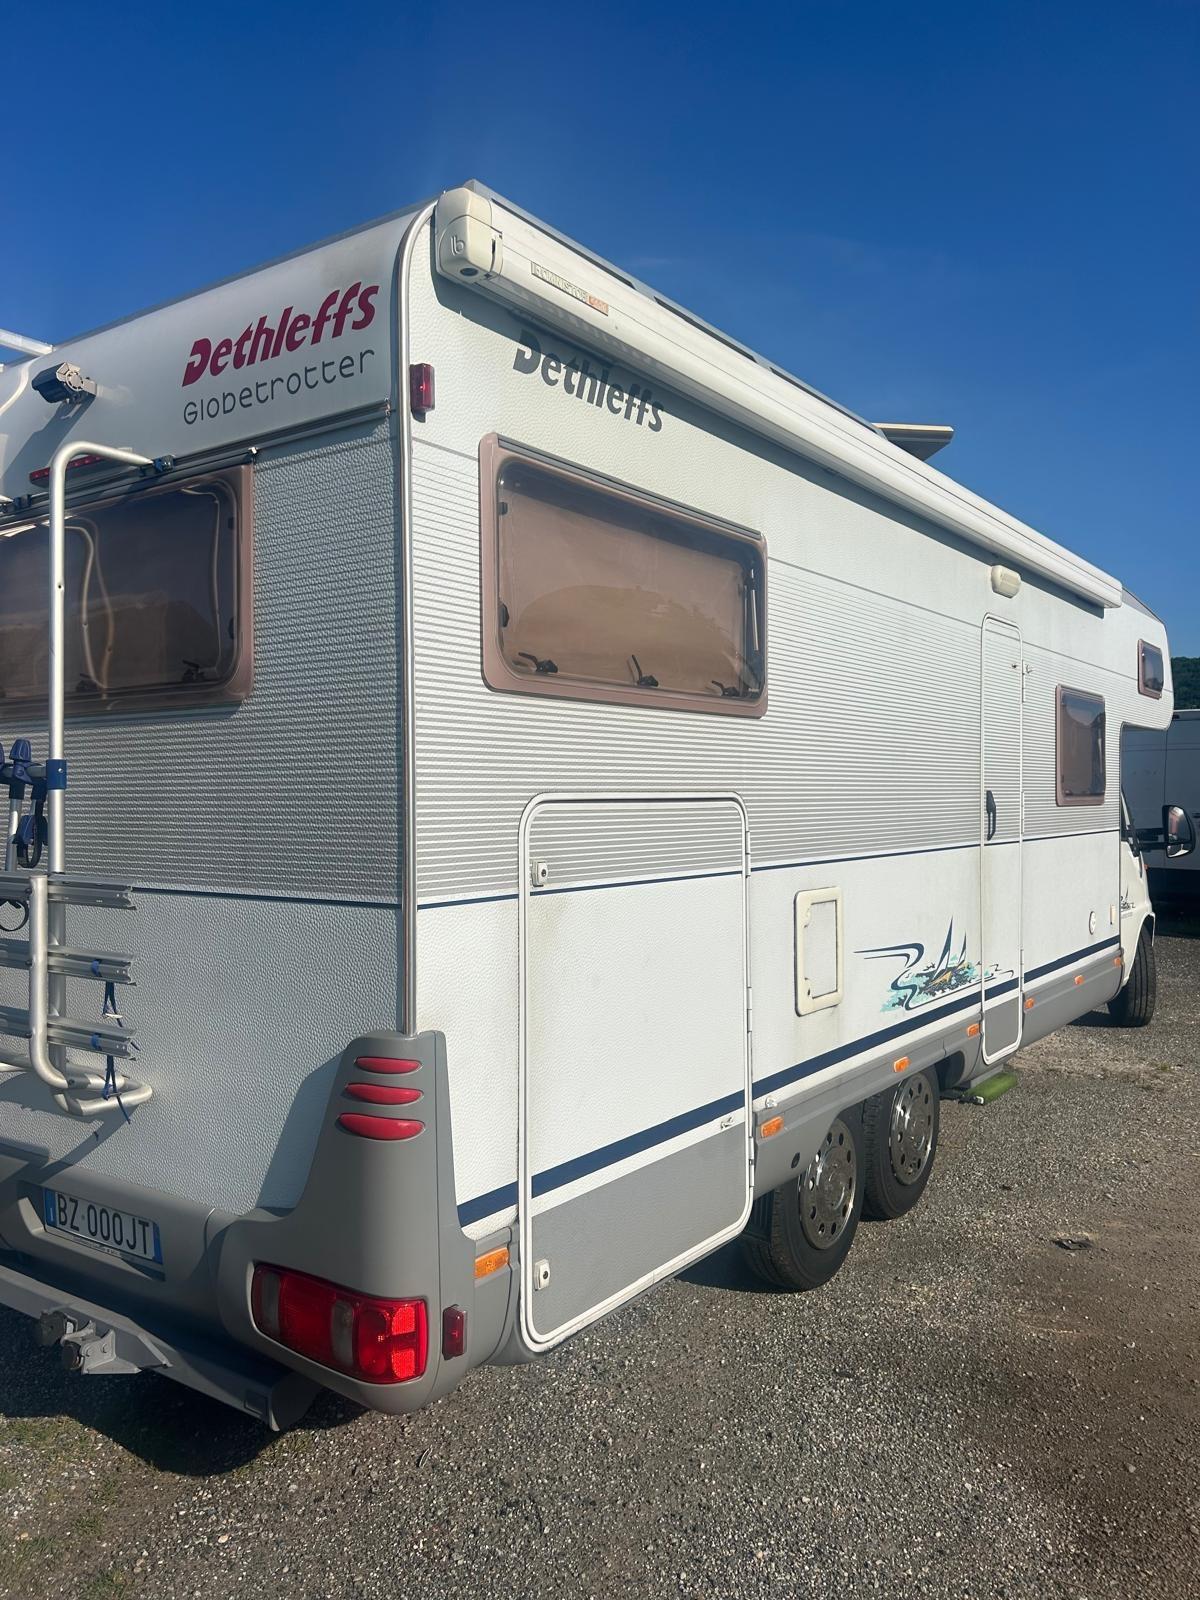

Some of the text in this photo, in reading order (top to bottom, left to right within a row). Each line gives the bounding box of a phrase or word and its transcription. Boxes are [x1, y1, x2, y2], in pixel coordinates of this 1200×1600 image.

[182, 281, 380, 387] Dethleffs
[183, 348, 375, 425] Globetrotter
[513, 329, 664, 433] Dethleffs
[57, 1193, 80, 1232] BZ
